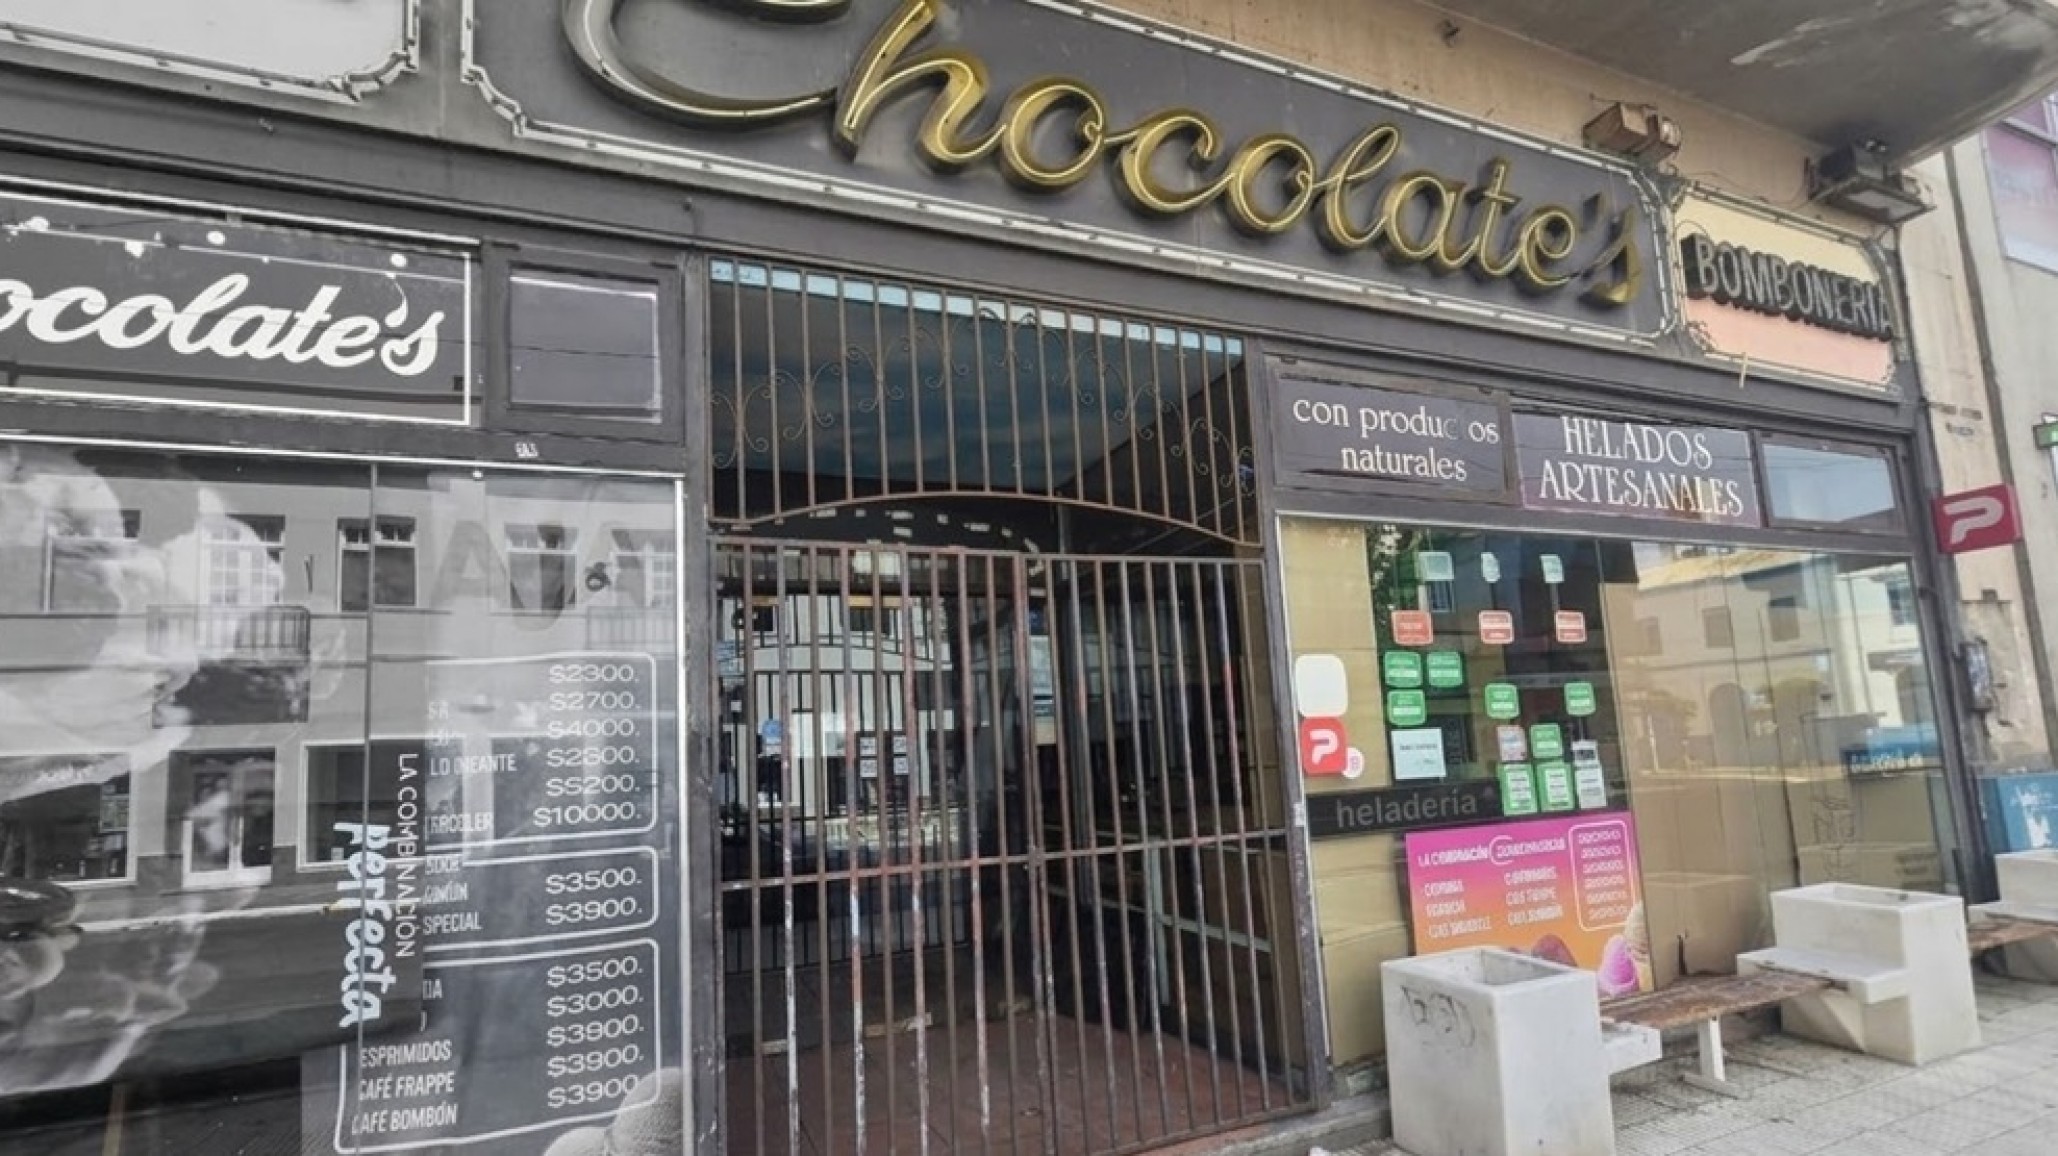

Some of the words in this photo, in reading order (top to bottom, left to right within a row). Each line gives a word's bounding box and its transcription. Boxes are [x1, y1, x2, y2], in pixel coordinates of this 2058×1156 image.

[1292, 399, 1349, 427] con
[1359, 405, 1500, 444] producos
[1559, 415, 1713, 470] HELADOS
[1340, 444, 1468, 482] naturales
[1539, 459, 1745, 517] ARTESANALES
[398, 753, 419, 781] LA
[333, 822, 396, 1028] perfecta
